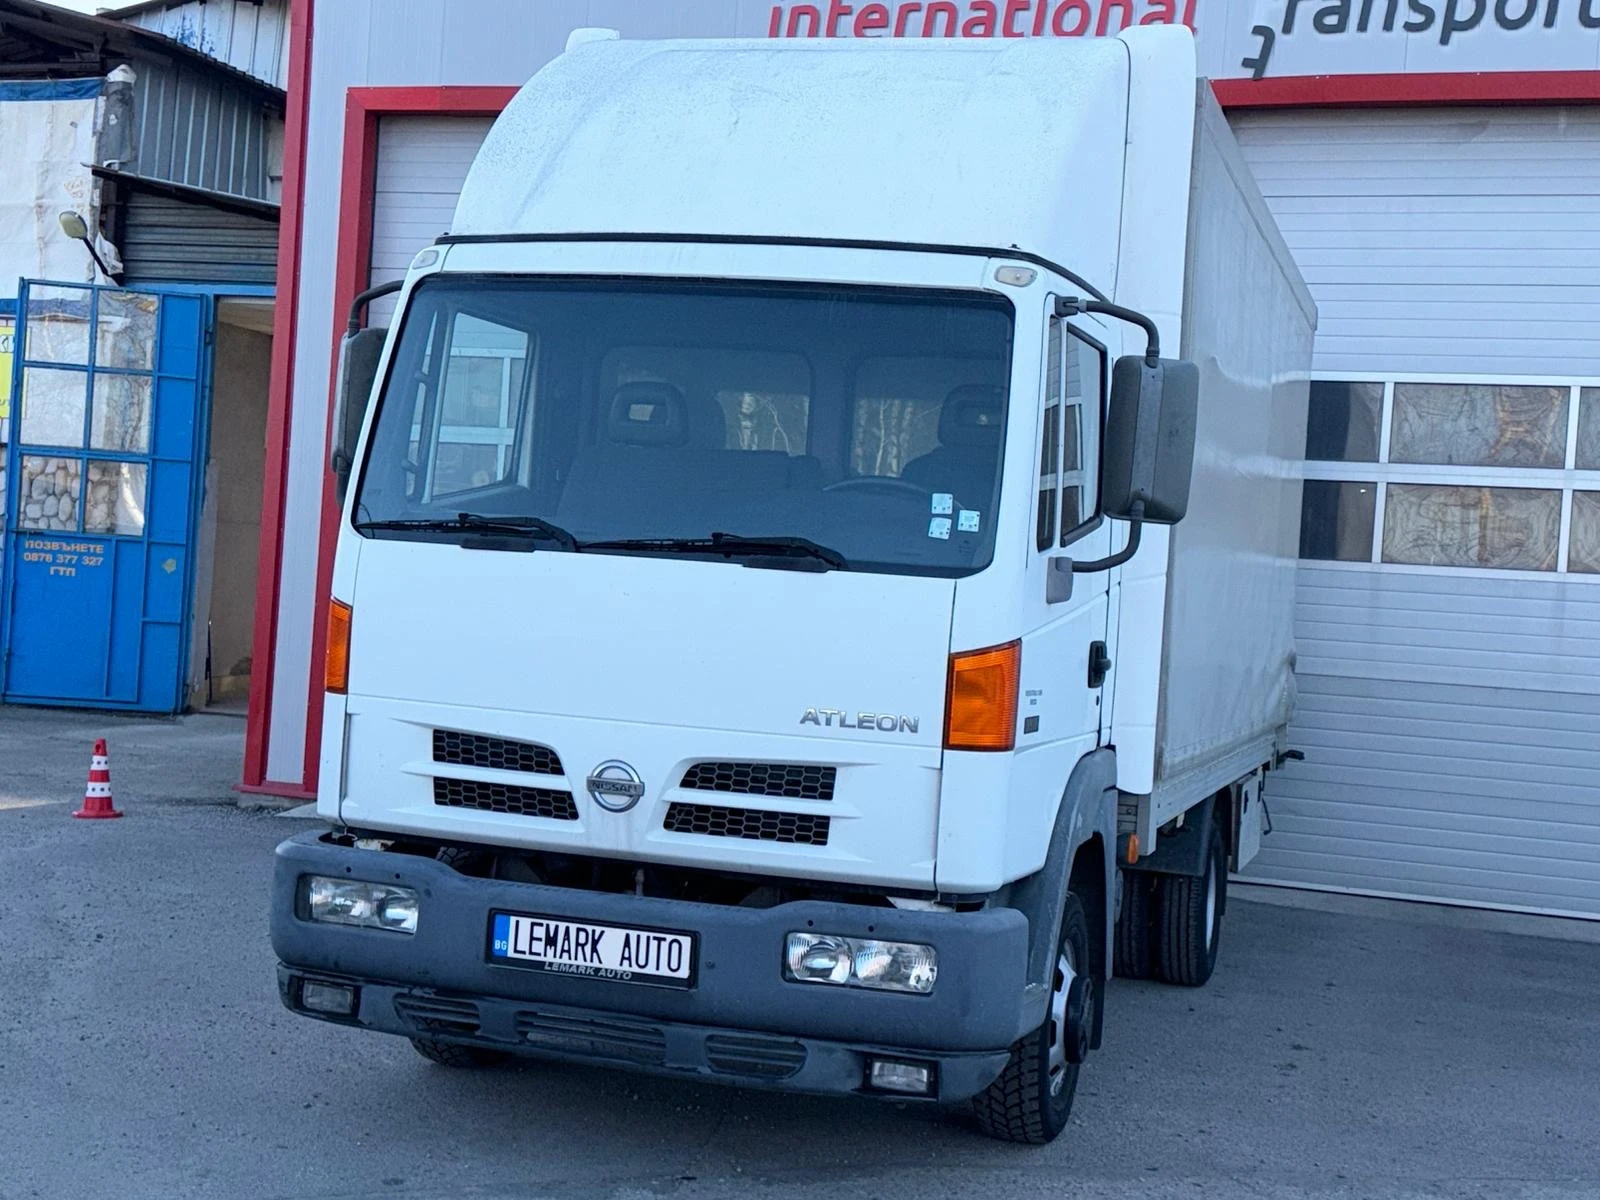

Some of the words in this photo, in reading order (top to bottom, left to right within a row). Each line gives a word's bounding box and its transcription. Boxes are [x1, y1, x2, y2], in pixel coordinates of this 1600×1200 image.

[768, 0, 1198, 38] international
[24, 540, 105, 554] ПОЗВЪНЕТЕ
[56, 554, 79, 565] 377
[49, 566, 76, 577] ГТП
[799, 706, 920, 734] ATLEON
[591, 781, 638, 794] NISSAN
[494, 940, 507, 951] BG
[512, 919, 606, 965] LEMARK
[619, 932, 684, 973] AUTO
[544, 961, 595, 976] LEMARK
[598, 968, 633, 981] AUTO
